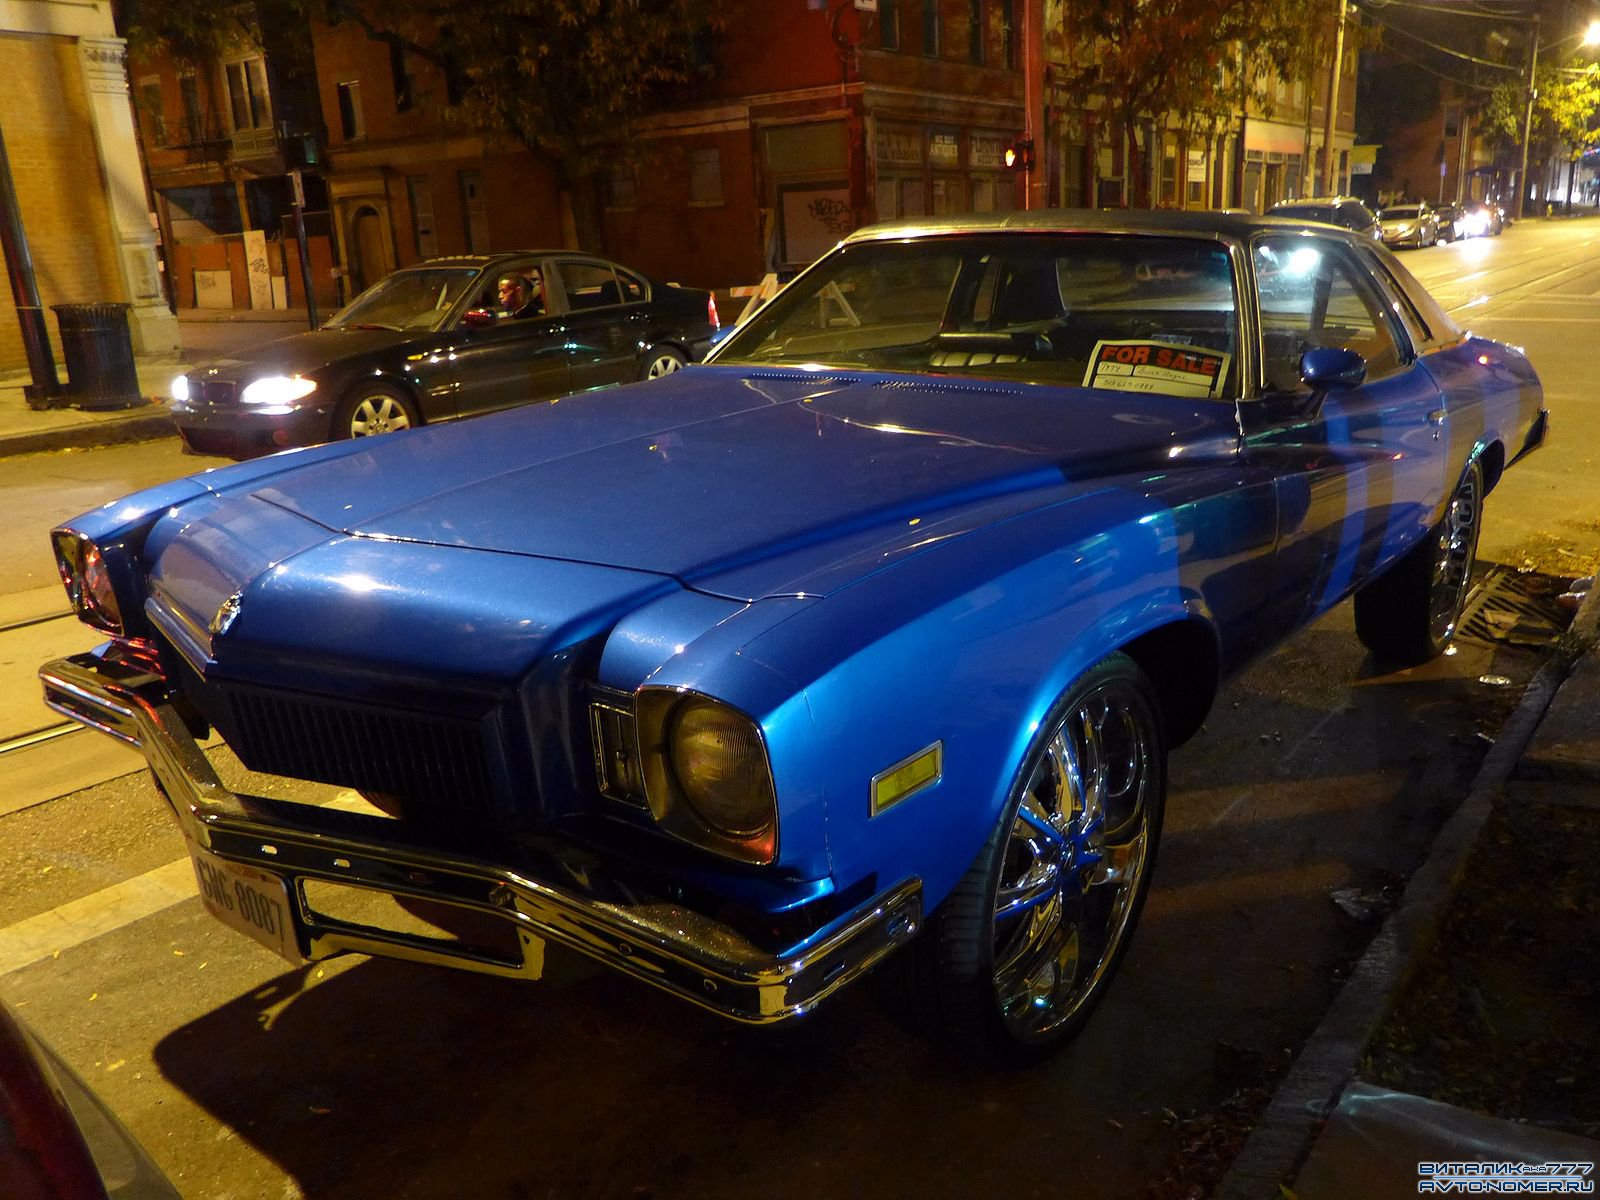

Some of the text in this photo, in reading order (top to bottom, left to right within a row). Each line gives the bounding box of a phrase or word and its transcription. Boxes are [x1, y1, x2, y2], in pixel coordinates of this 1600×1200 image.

[1101, 347, 1217, 375] FOR SALE
[235, 880, 284, 941] 8087
